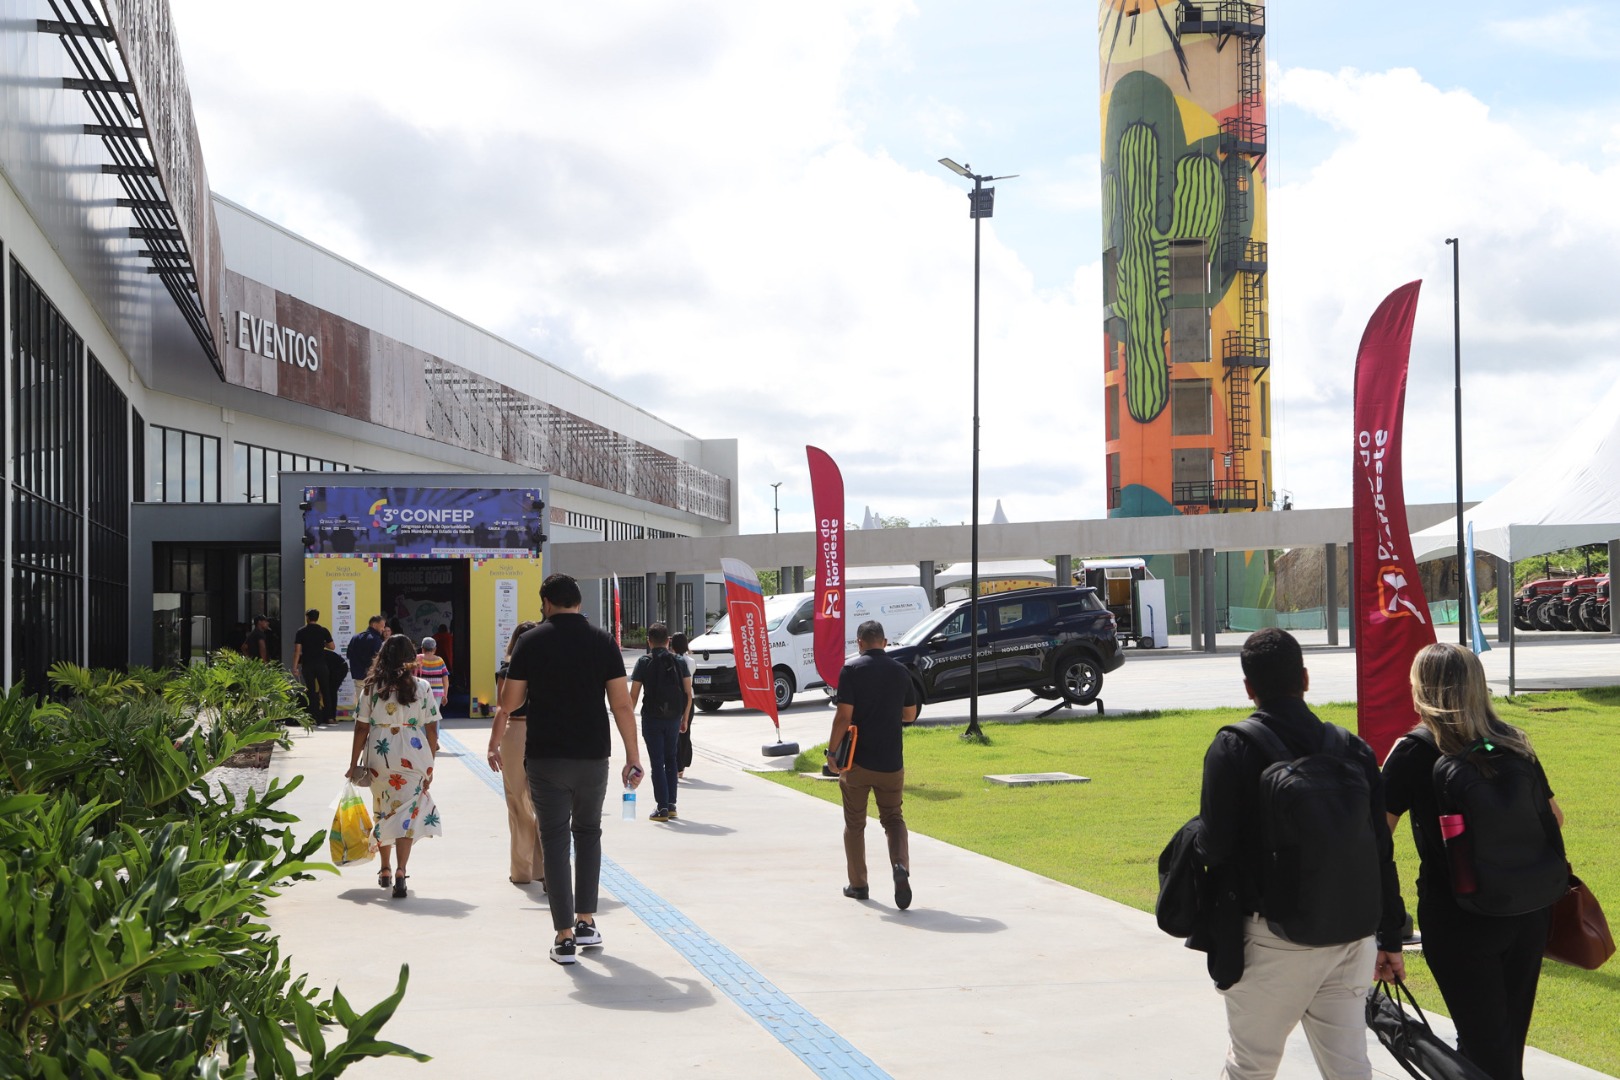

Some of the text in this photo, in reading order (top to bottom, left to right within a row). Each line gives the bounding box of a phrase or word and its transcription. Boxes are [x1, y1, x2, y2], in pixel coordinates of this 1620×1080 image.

[238, 310, 319, 372] EVENTOS
[400, 508, 475, 523] CONFEP
[820, 519, 830, 538] do
[829, 519, 840, 587] Nordeste
[740, 625, 752, 669] RODADA
[745, 612, 760, 680] DE NEGÓCIOS
[759, 626, 770, 667] CITROËN
[935, 649, 993, 664] TEST DRIVE CROËN
[1019, 641, 1049, 651] AIRCROSS
